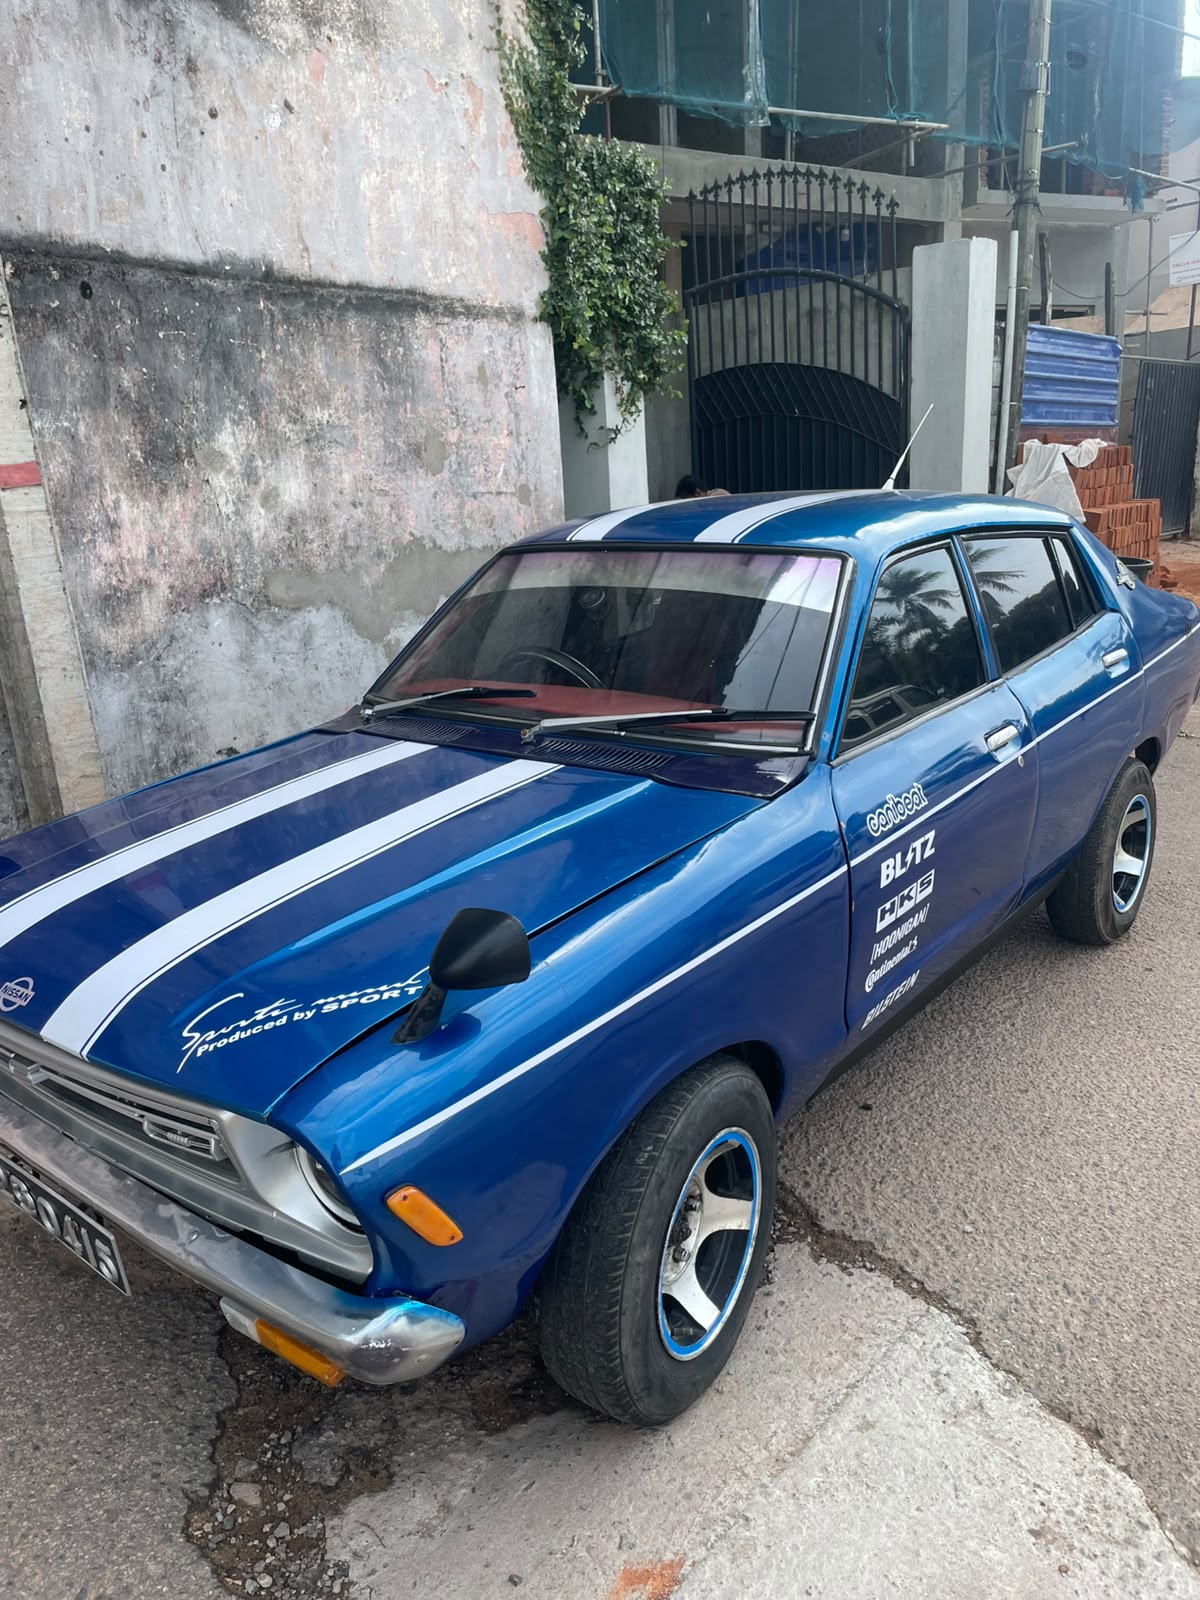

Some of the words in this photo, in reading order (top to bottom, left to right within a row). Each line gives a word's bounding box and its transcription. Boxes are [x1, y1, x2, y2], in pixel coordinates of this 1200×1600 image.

[880, 829, 935, 889] BLITZ
[876, 869, 935, 933] HKS
[0, 983, 32, 1003] NISSAN
[861, 969, 920, 1030] BILSTEIN
[197, 1016, 287, 1057] Produced
[293, 1009, 316, 1021] by
